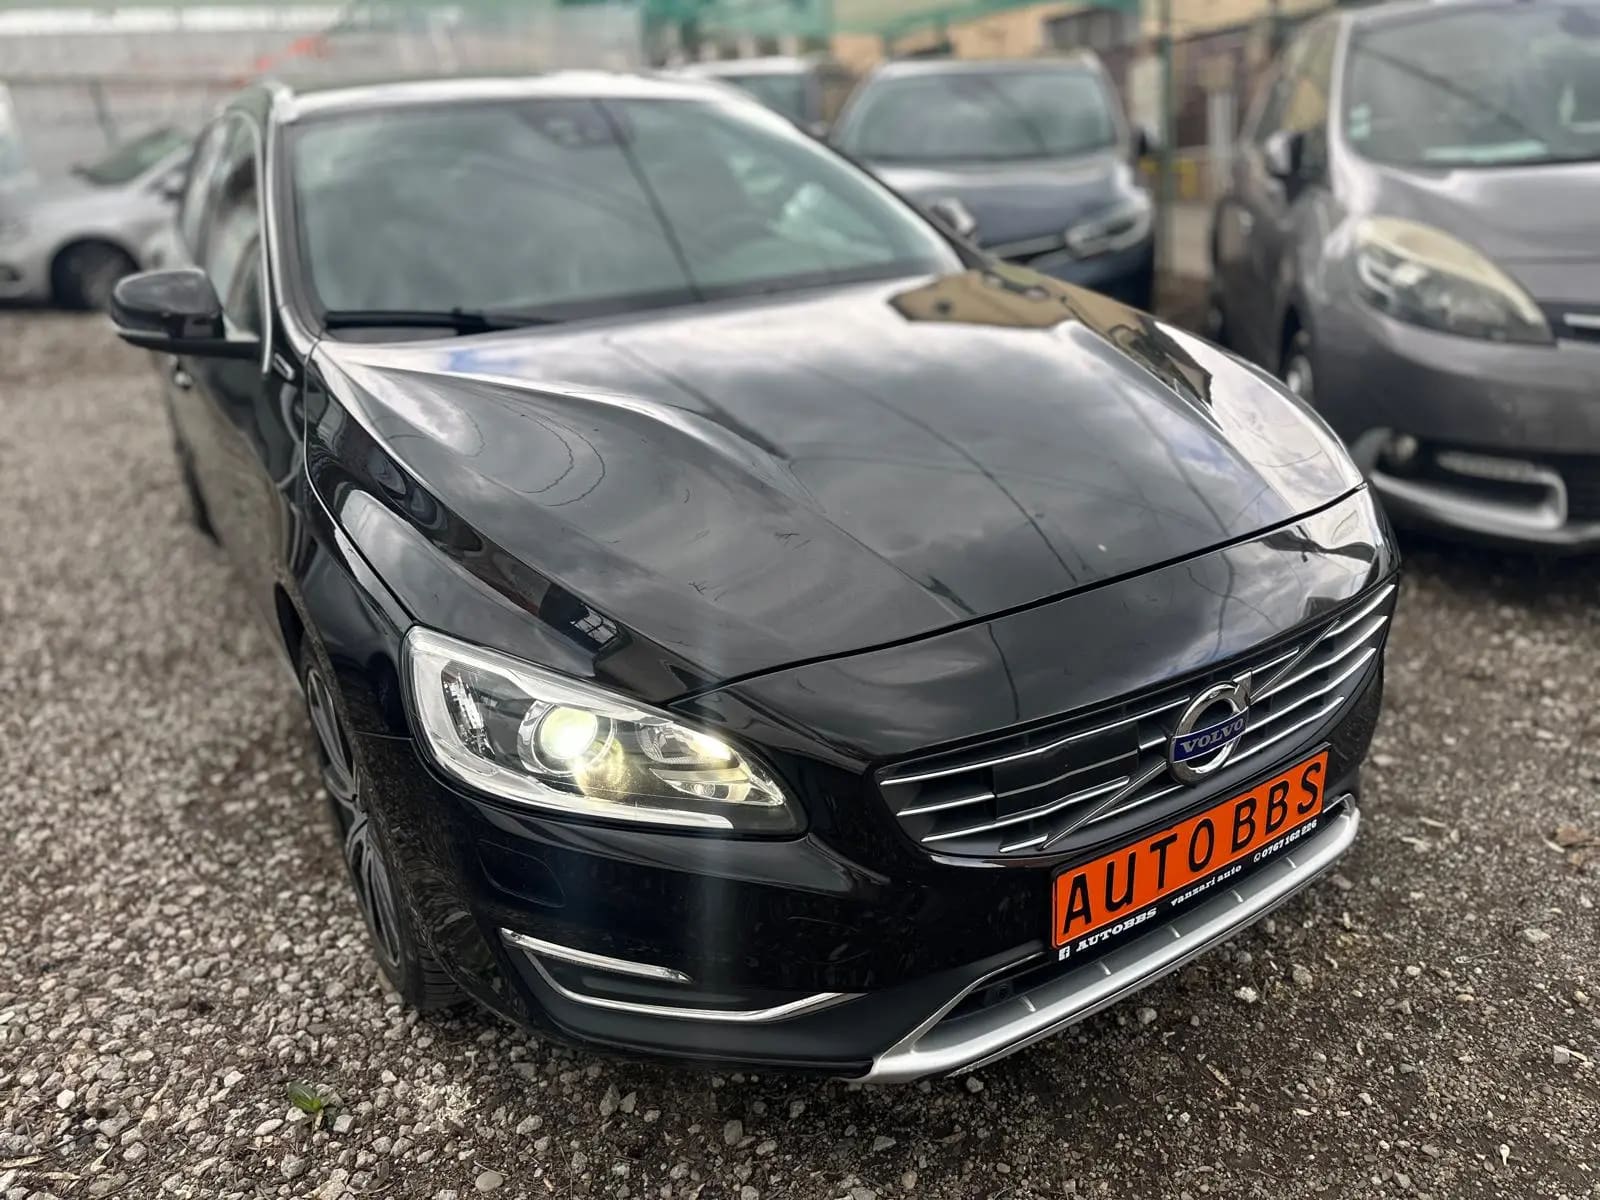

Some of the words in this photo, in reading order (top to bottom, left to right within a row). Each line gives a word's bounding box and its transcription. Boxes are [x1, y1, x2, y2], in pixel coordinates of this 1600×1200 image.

[1181, 718, 1244, 753] VOLVO
[1075, 907, 1157, 952] AUTOBBS
[1170, 876, 1216, 907] vanzari
[1217, 864, 1242, 882] auto
